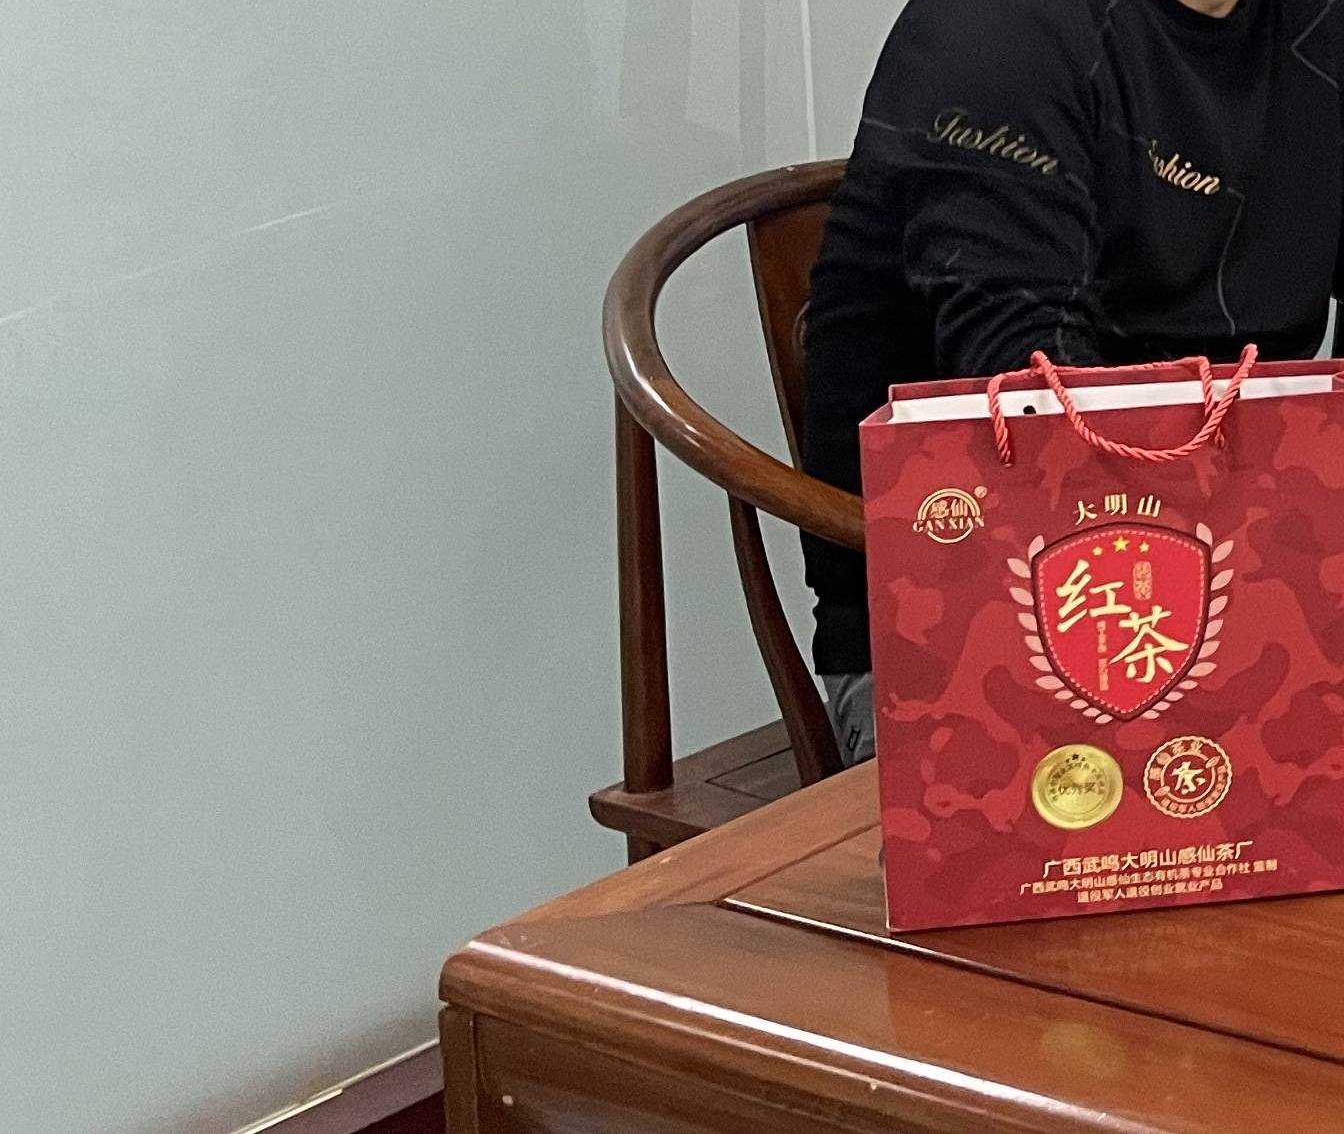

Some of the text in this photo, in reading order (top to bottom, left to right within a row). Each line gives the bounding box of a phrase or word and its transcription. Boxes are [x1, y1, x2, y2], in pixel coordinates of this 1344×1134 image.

[927, 108, 1058, 174] Fashion
[1148, 139, 1221, 195] shion
[948, 516, 985, 530] XIAN
[1072, 493, 1161, 526] 大明山
[1056, 559, 1190, 683] 红茶
[1043, 840, 1254, 879] 广西武鸣大明山感仙茶厂
